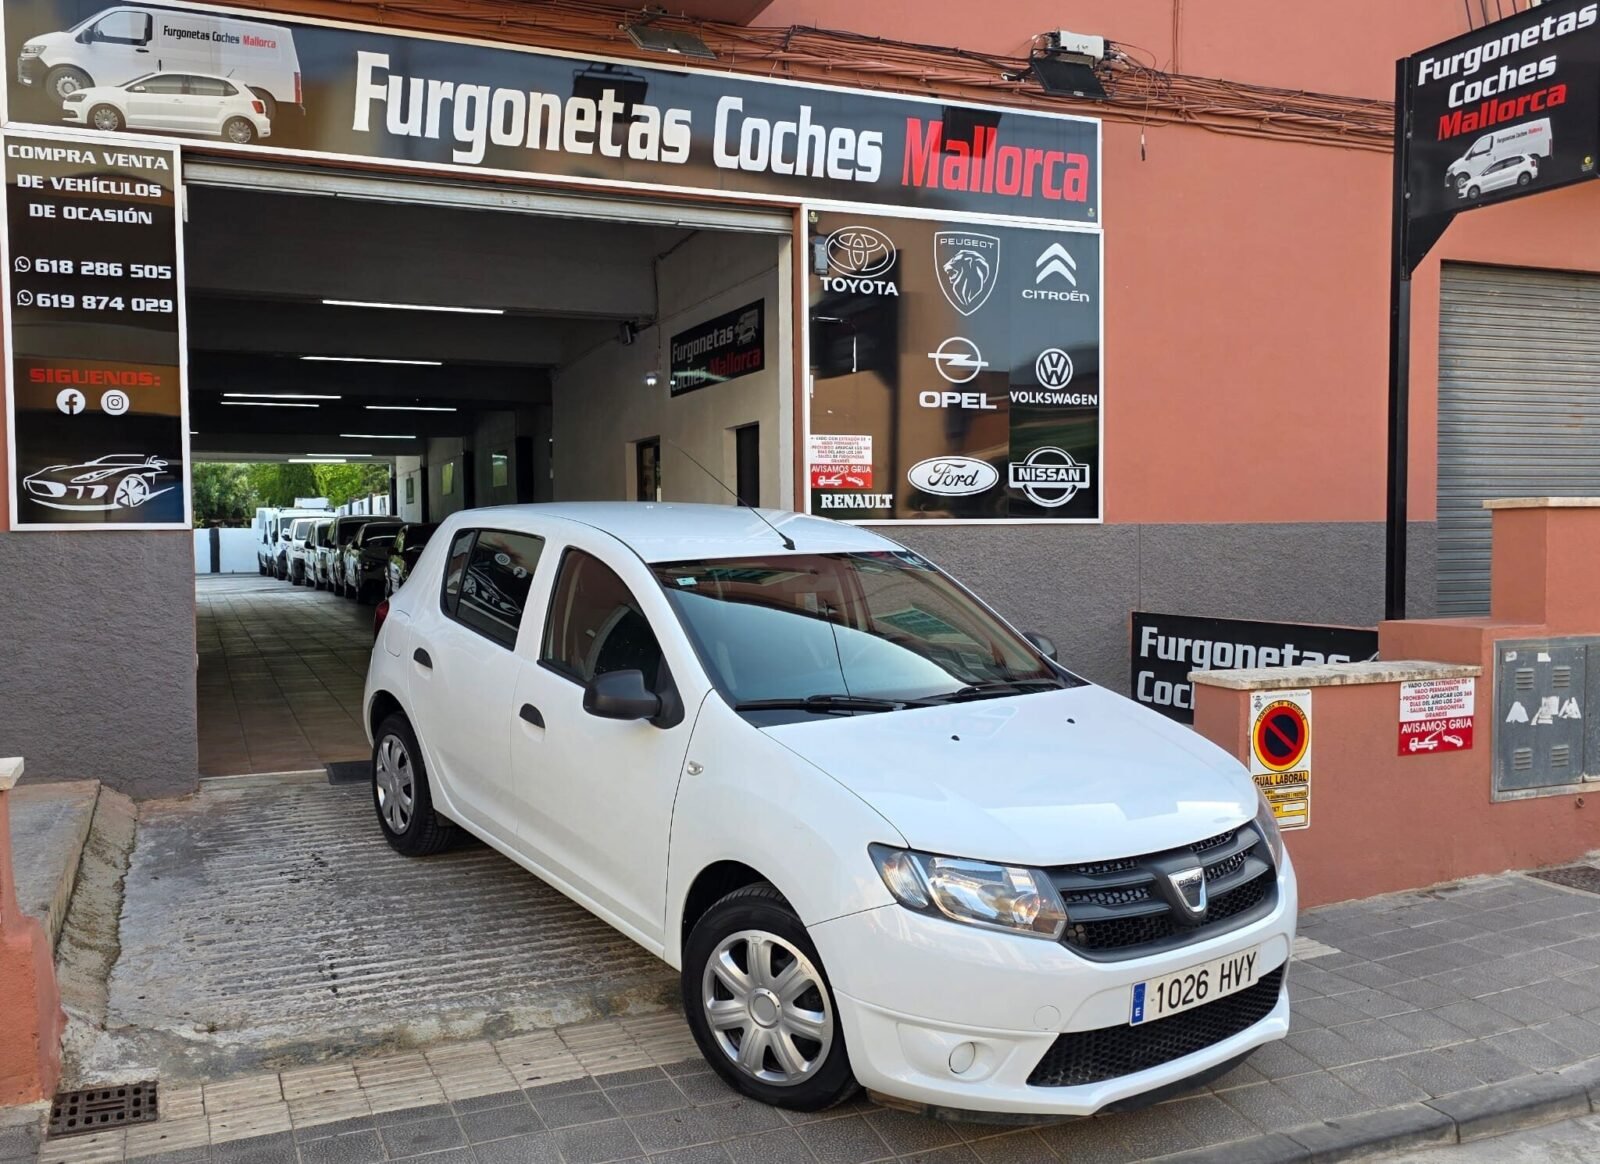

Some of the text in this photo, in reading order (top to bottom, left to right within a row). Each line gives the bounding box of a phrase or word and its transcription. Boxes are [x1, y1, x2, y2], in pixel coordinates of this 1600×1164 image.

[163, 25, 276, 48] Furgonetas Coches Mallorca
[1417, 3, 1597, 86] Furgonetas
[1448, 55, 1557, 109] Coches
[1437, 84, 1567, 141] Mallorca
[352, 50, 1089, 202] Furgonetas Coches Mallorca
[7, 144, 169, 170] COMPRA VENTA
[17, 174, 162, 198] DE VEHÍCULOS
[29, 204, 152, 225] DE OCASIÓN
[940, 238, 995, 250] PEUGEOT
[35, 258, 172, 280] 618 286 505
[820, 276, 899, 296] TOYOTA
[36, 293, 173, 313] 619 874 029
[672, 326, 734, 363] Furgonetas
[29, 367, 161, 387] SIGUENOS:
[919, 391, 997, 409] OPEL
[1010, 390, 1098, 406] VOLKSWAGEN
[811, 465, 849, 473] AVISAMOS
[927, 462, 979, 487] Ford
[1018, 468, 1080, 481] NISSAN
[820, 494, 893, 508] RENAULT
[1401, 718, 1472, 734] AVISAMOS GRUA
[1275, 773, 1306, 785] LABORAL
[1157, 952, 1256, 1013] 1026 HVY
[1135, 1007, 1141, 1017] E
